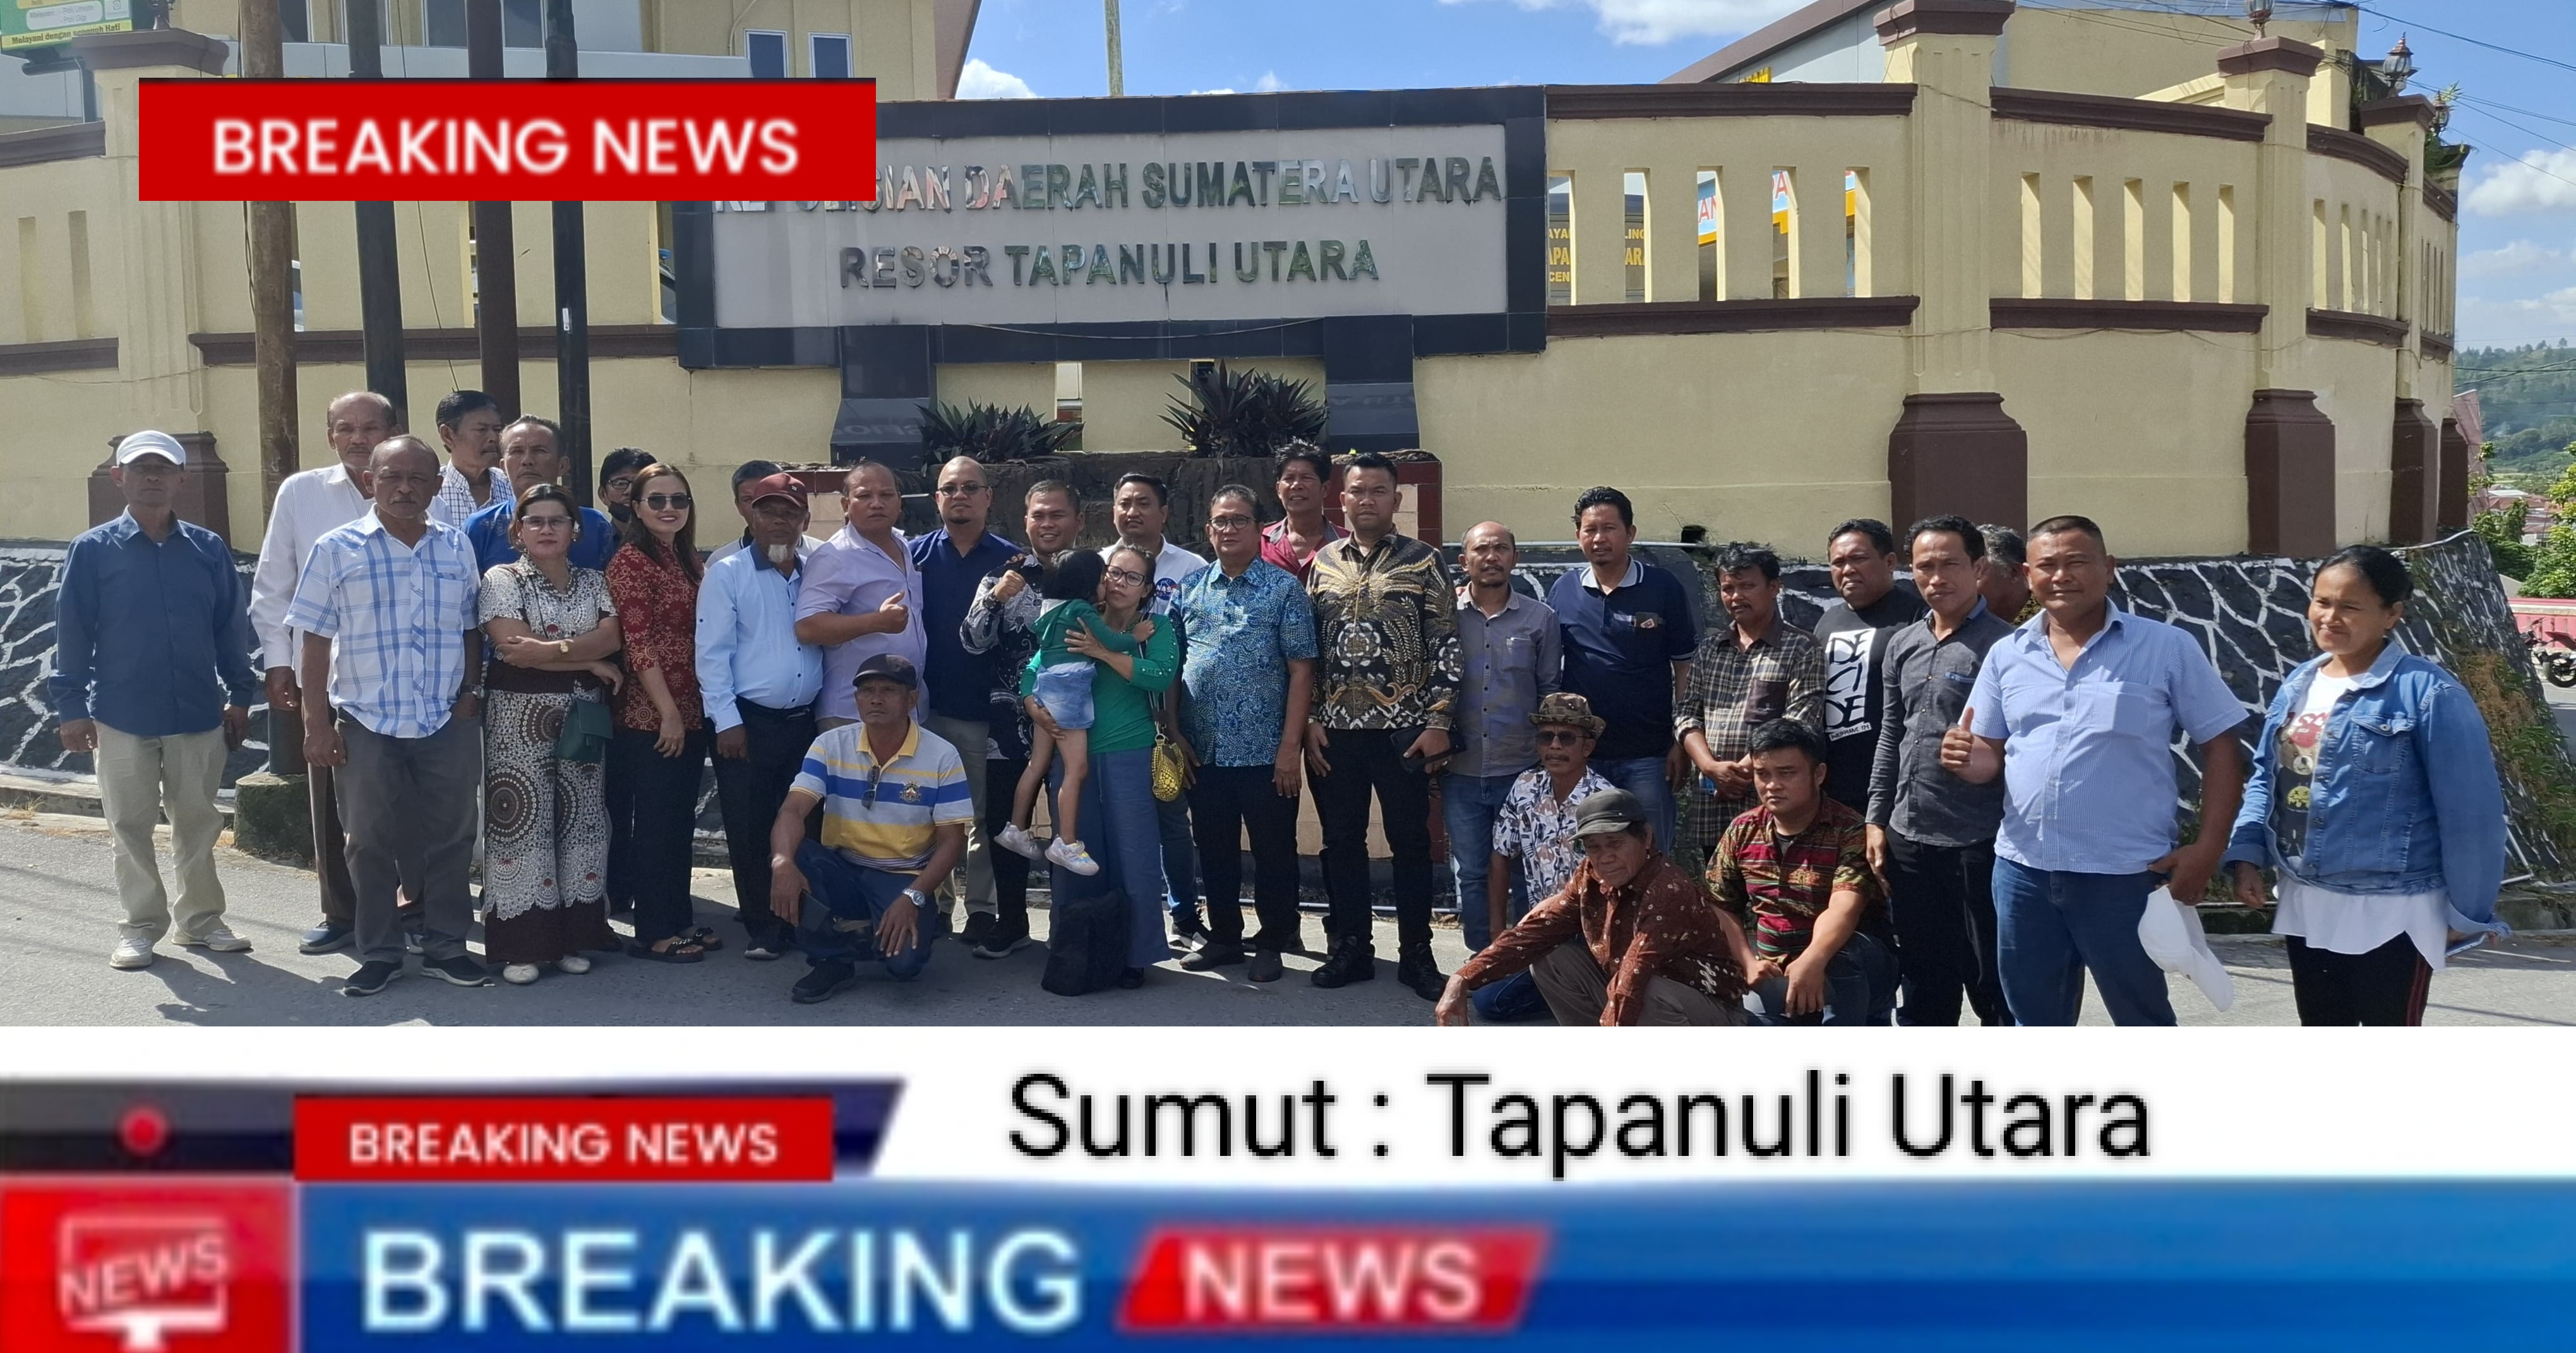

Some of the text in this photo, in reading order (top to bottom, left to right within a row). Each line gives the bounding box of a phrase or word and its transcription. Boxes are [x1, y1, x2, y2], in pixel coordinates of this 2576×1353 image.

[11, 33, 44, 44] Melayani
[45, 32, 71, 40] dengan
[964, 163, 1129, 210] DAERAH
[1142, 159, 1359, 208] SUMATERA
[1369, 156, 1502, 205] UTARA
[839, 239, 1379, 288] RESOR TAPANULI UTARA
